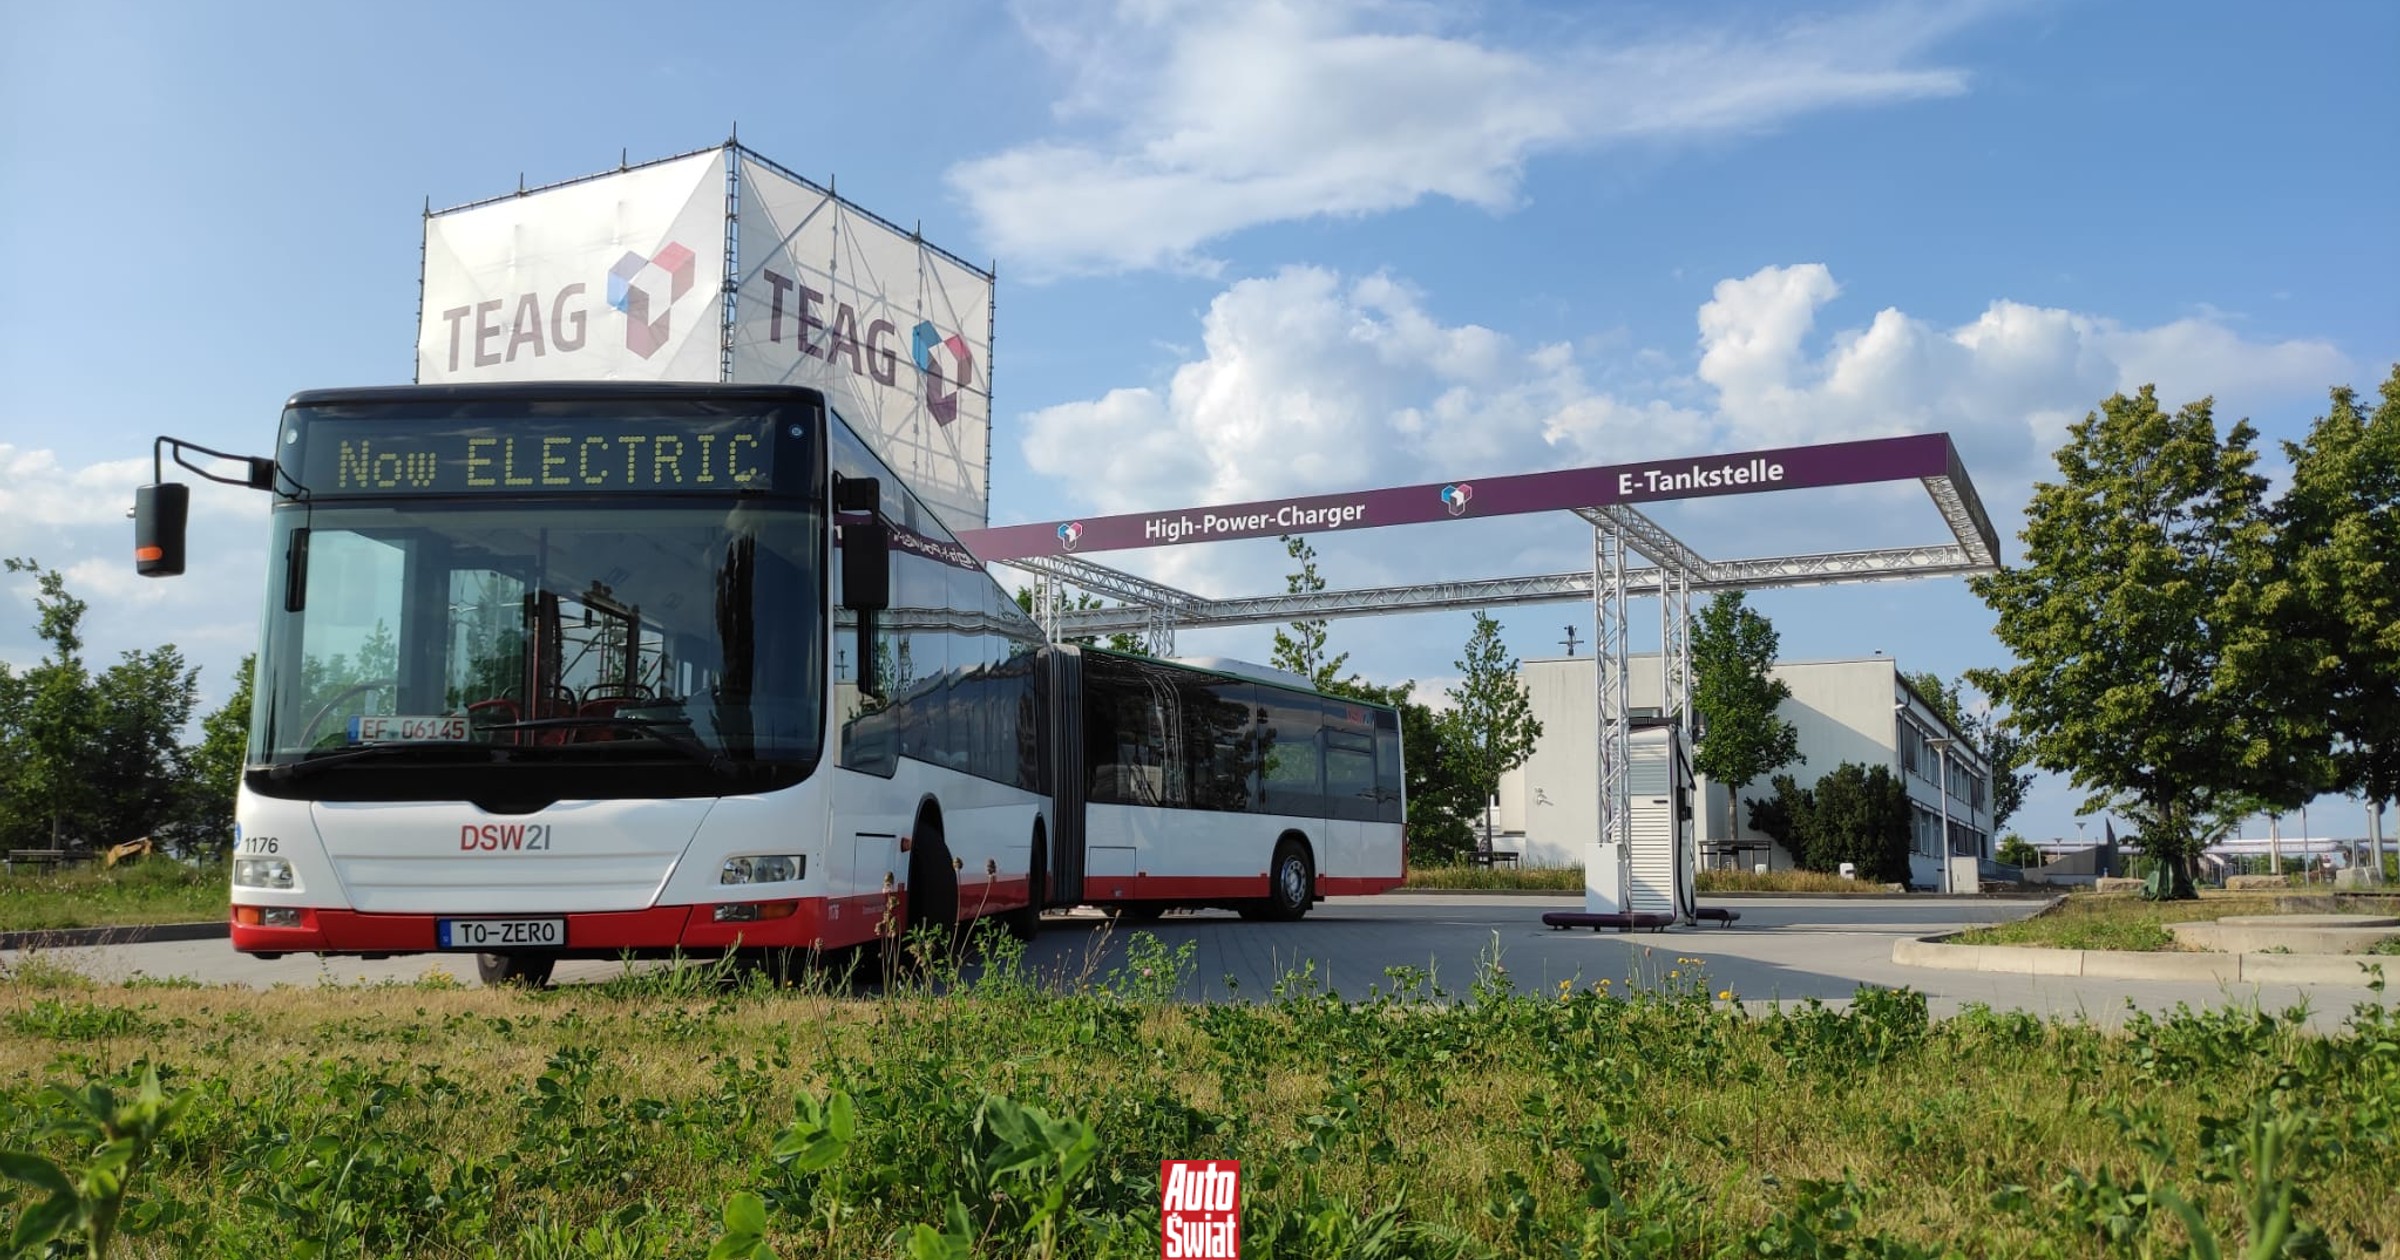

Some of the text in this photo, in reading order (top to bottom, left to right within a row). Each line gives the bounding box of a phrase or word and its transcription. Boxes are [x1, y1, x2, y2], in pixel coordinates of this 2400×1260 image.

[443, 282, 588, 373] TEAG
[763, 268, 897, 387] TEAG
[338, 434, 758, 488] Now ELECTRIC
[1618, 459, 1785, 496] E-Tankstelle
[1144, 502, 1367, 542] High-Power-Charger
[362, 719, 465, 740] EF 06145
[245, 836, 279, 854] 1176
[460, 922, 555, 944] TO-ZERO
